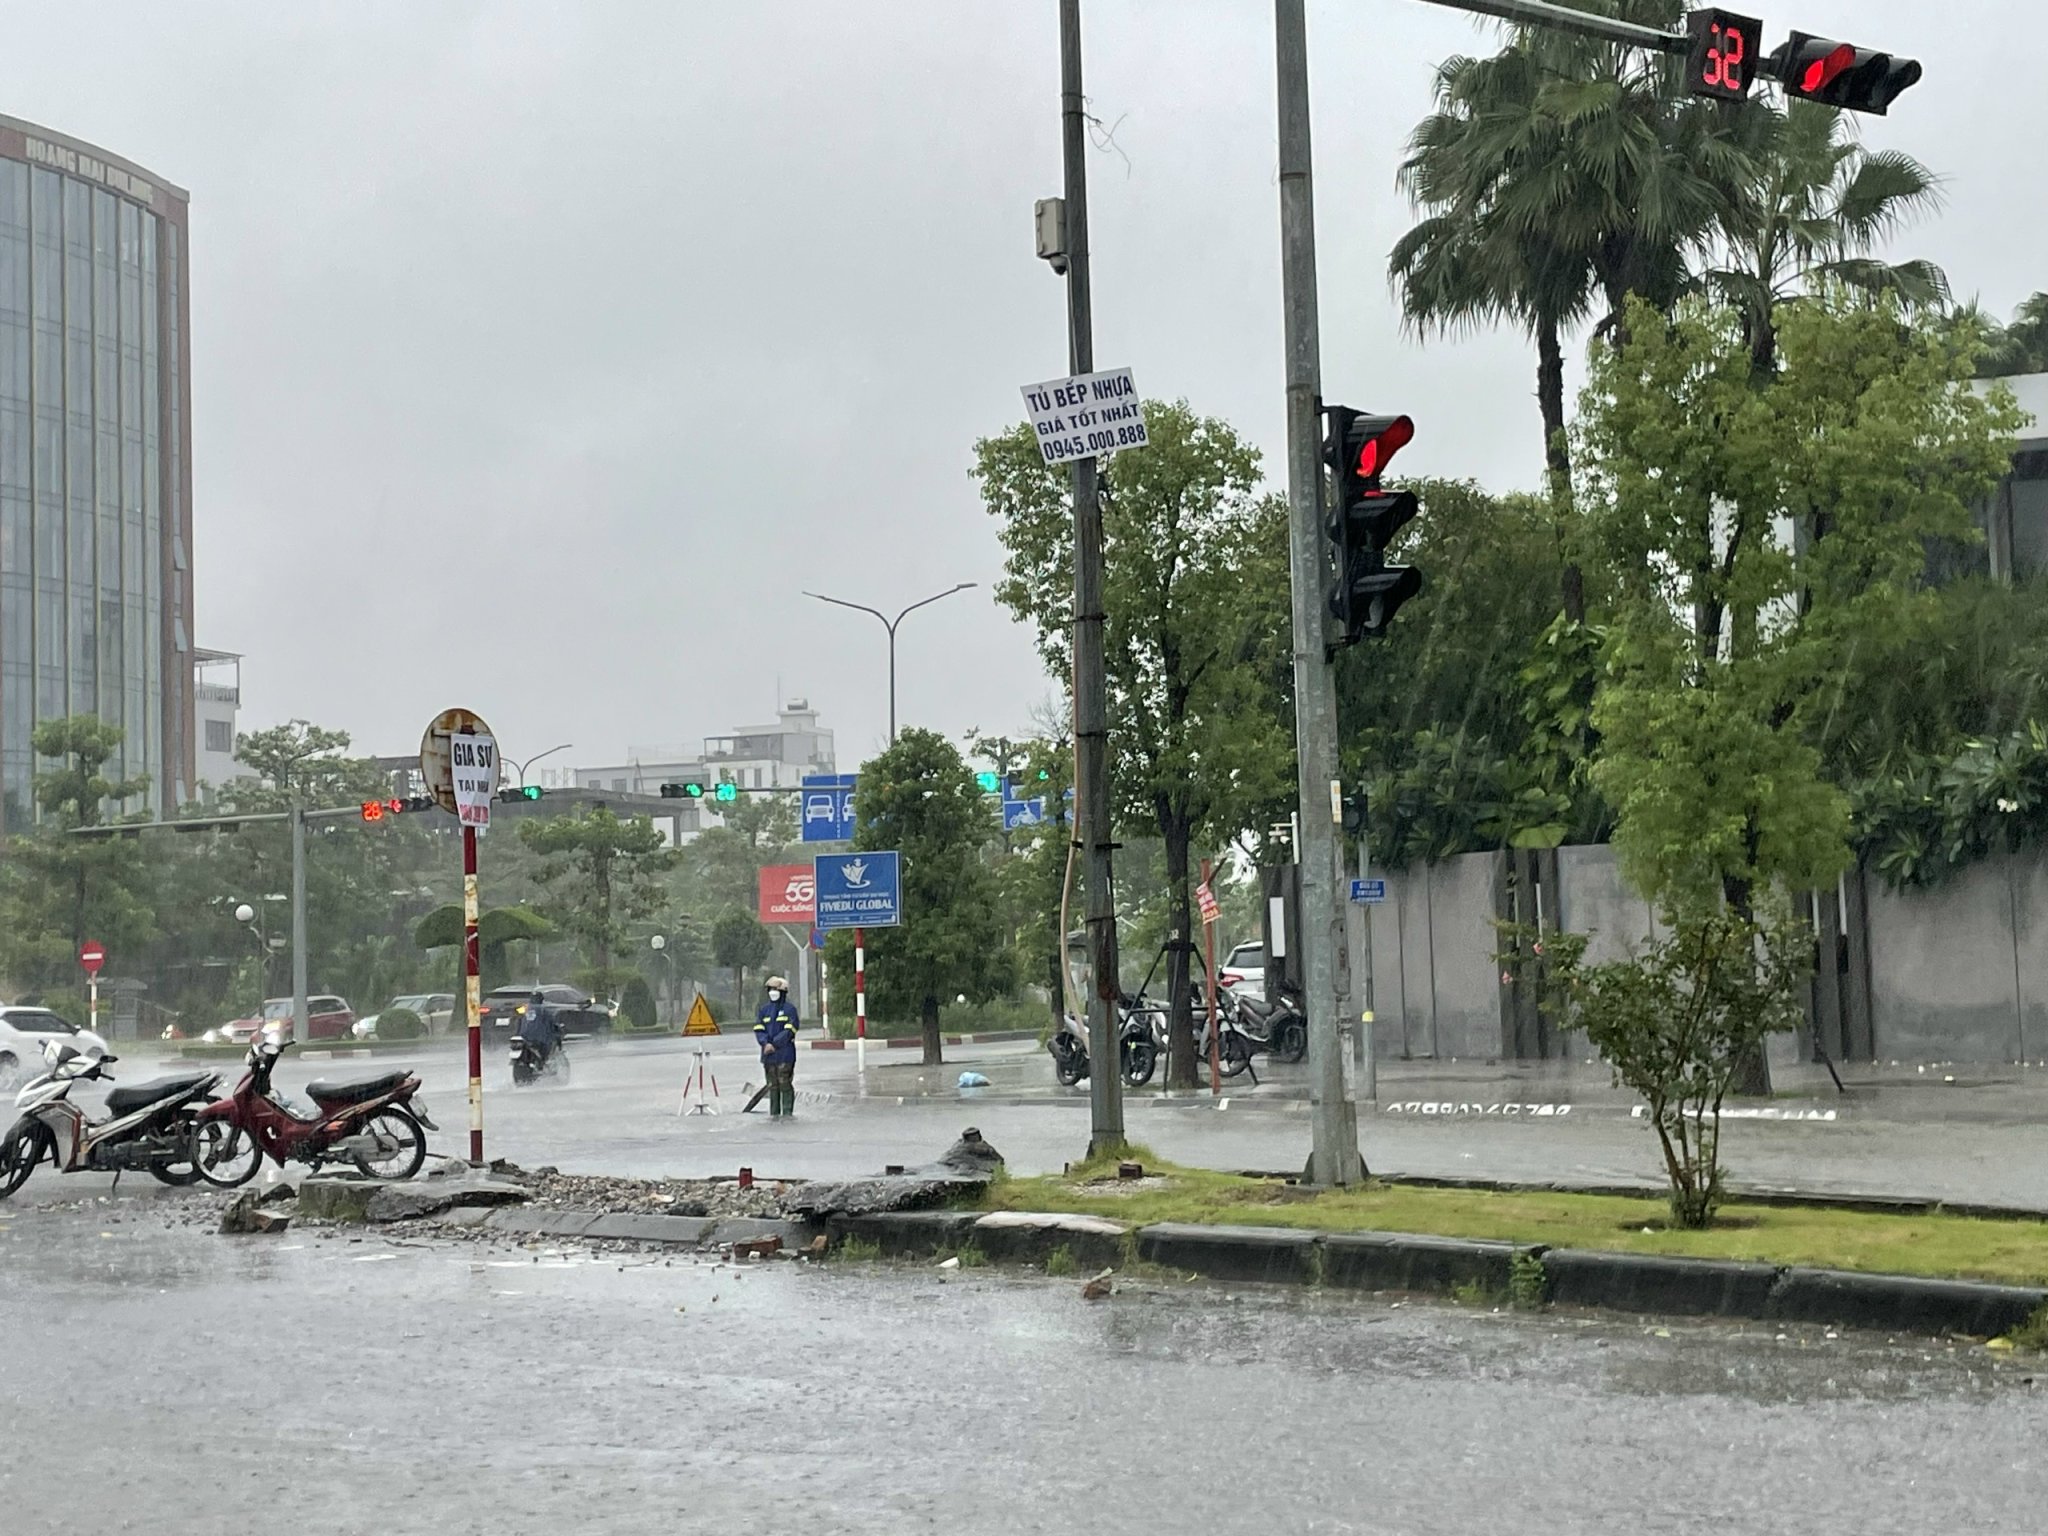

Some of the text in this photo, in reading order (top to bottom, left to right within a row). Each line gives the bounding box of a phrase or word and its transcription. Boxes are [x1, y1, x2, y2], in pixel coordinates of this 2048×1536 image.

[1028, 375, 1133, 412] TỦ BẾP NHỰA
[1037, 400, 1138, 435] GIÁ TỐT NHẤT
[1043, 424, 1146, 460] 0945.000.888
[454, 743, 475, 766] GIA
[458, 779, 475, 794] TẠI
[785, 881, 814, 902] 5G
[856, 899, 894, 910] GLOBAL
